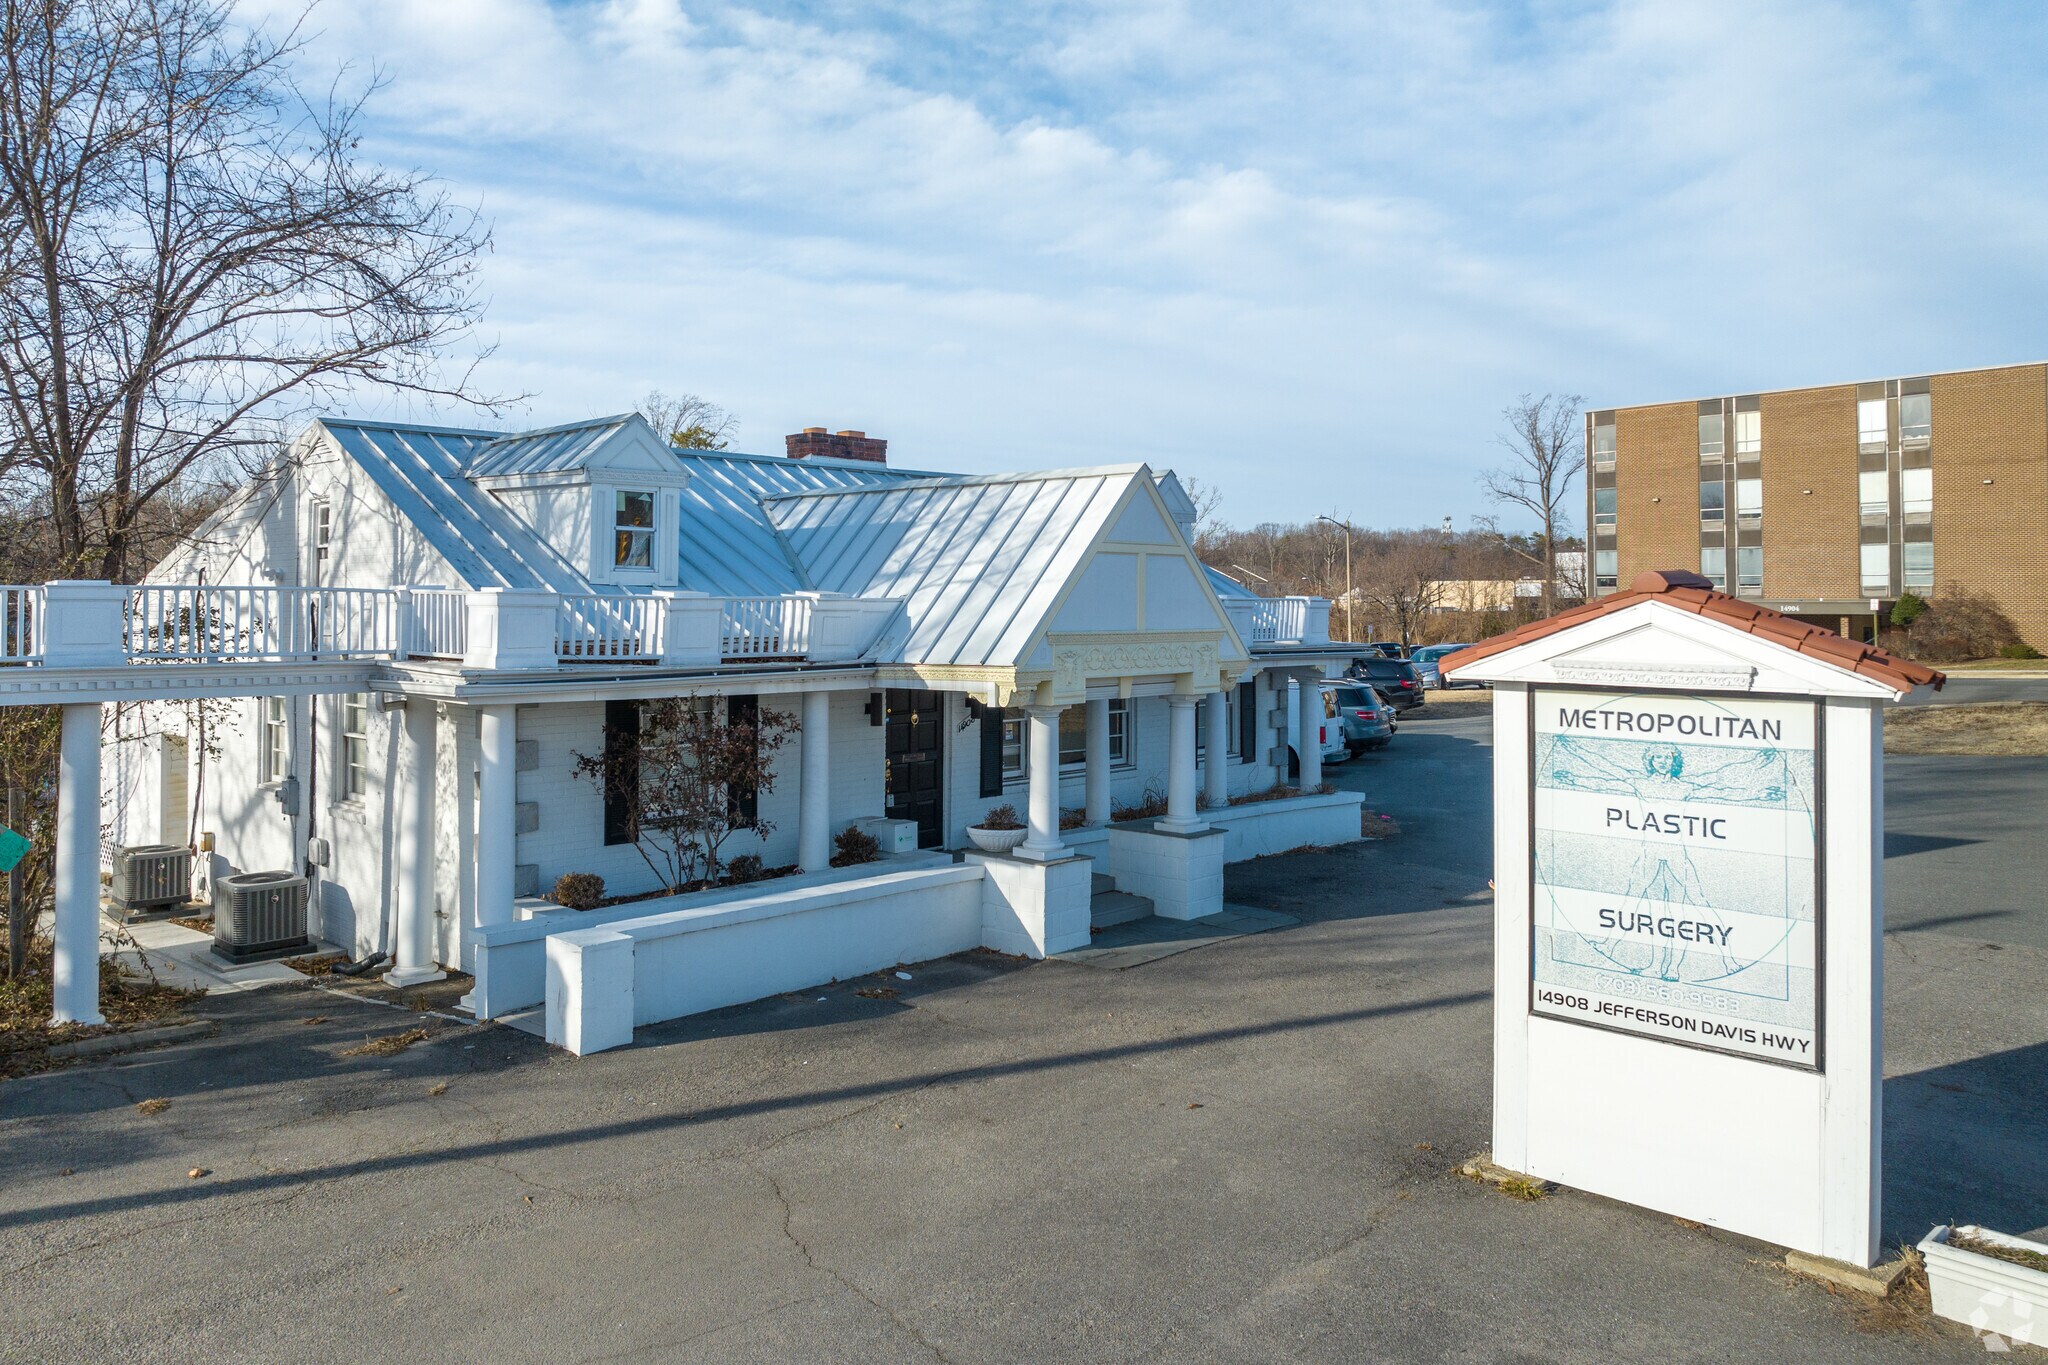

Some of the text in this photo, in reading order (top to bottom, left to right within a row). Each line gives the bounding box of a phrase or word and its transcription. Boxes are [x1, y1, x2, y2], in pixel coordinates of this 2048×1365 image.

[1559, 708, 1781, 740] METROPOLITAN
[1607, 808, 1727, 840] PLASTIC
[1599, 908, 1733, 946] SURGERY
[1595, 972, 1641, 996] (703)
[1538, 989, 1810, 1054] 14908 JEFFERSON DAVIS HWY
